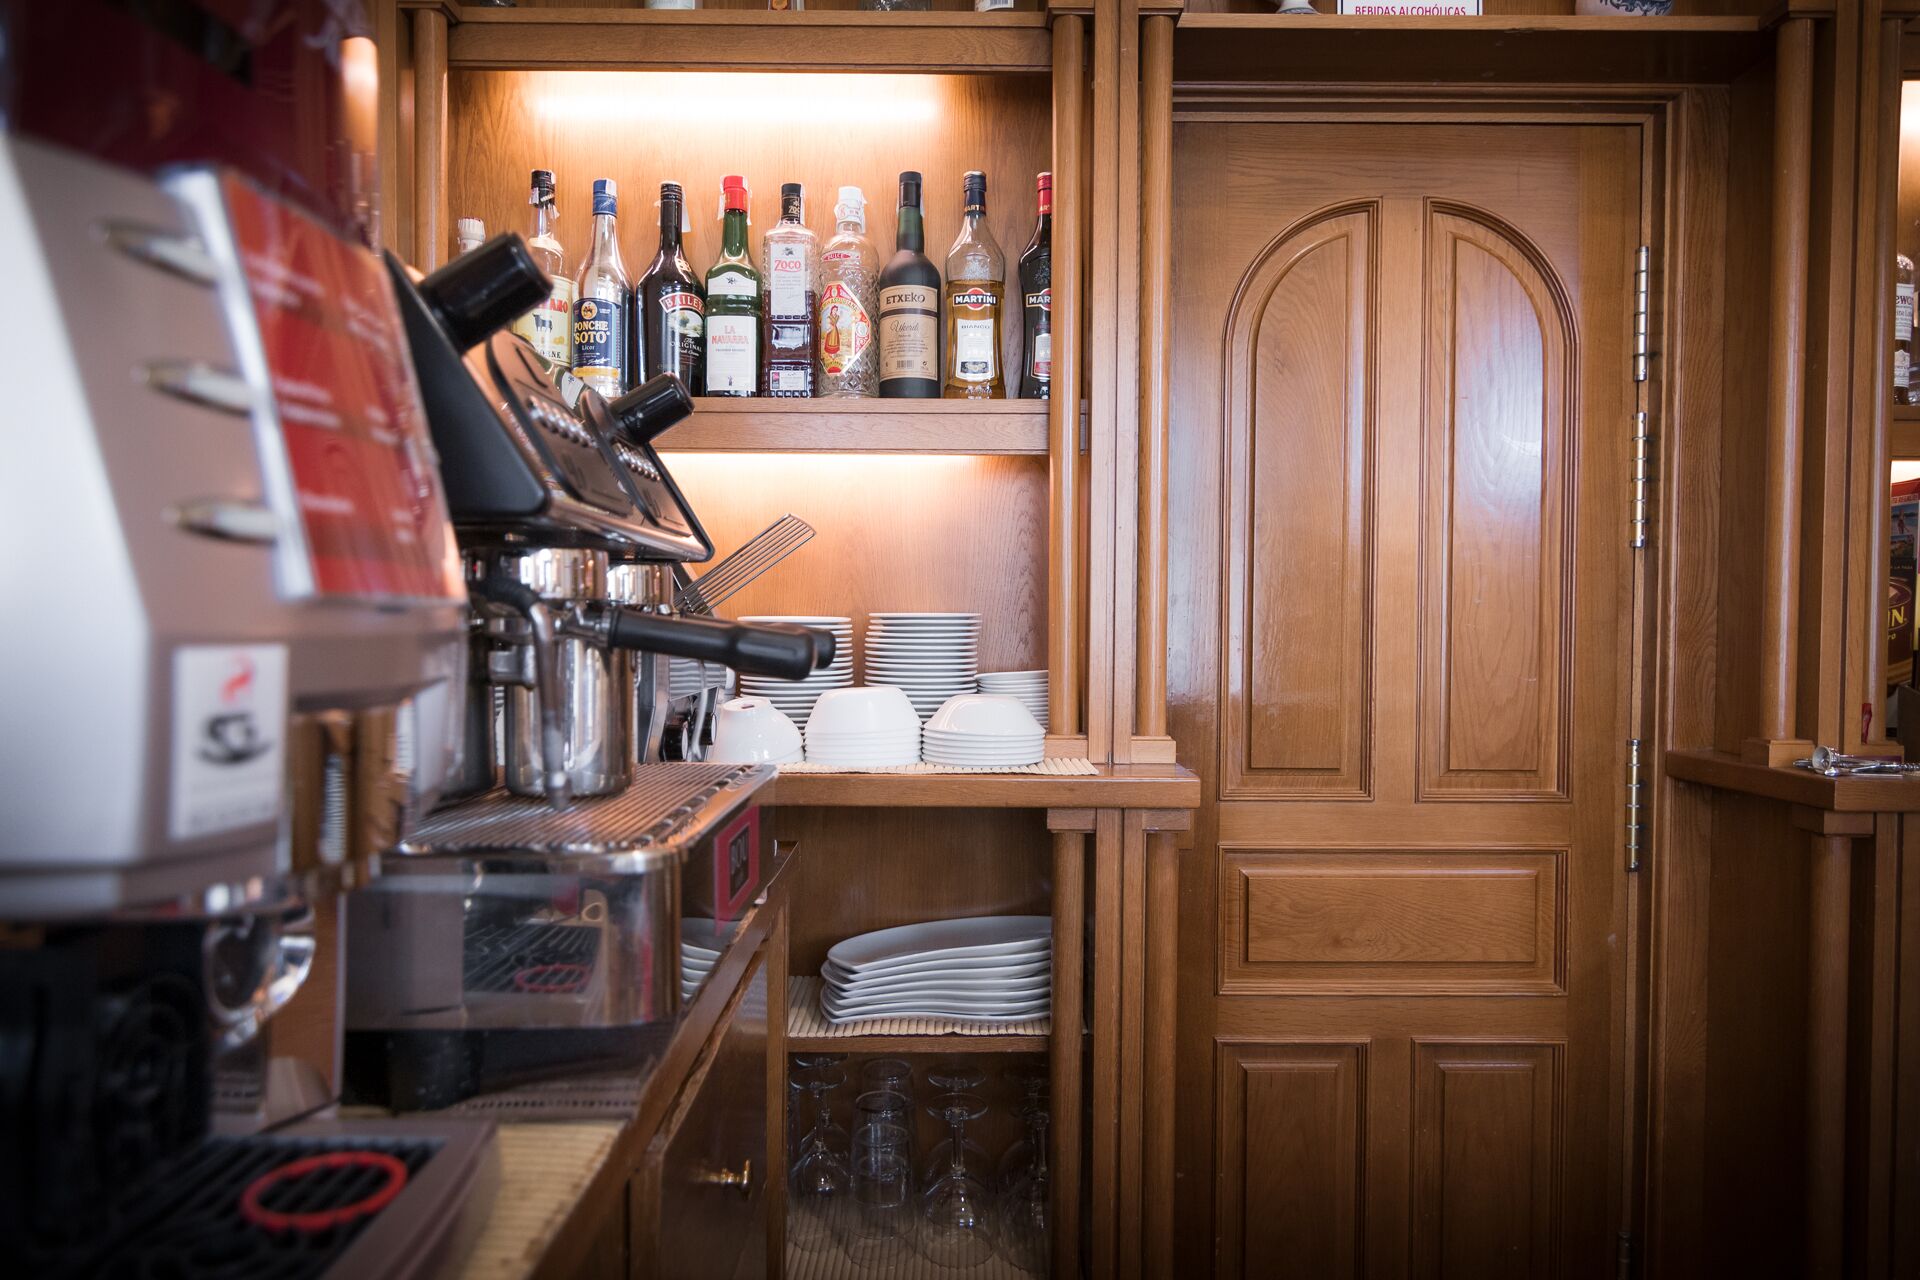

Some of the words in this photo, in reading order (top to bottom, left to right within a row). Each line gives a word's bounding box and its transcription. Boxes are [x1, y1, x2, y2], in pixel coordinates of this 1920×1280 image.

[1355, 6, 1396, 16] BEBIDAS
[1400, 3, 1466, 16] ALCOHÓLICAS
[774, 259, 801, 272] ZOCO
[955, 294, 996, 305] MARTINI
[1028, 295, 1051, 305] MAR
[574, 320, 609, 332] PONCHE
[724, 325, 736, 334] LA
